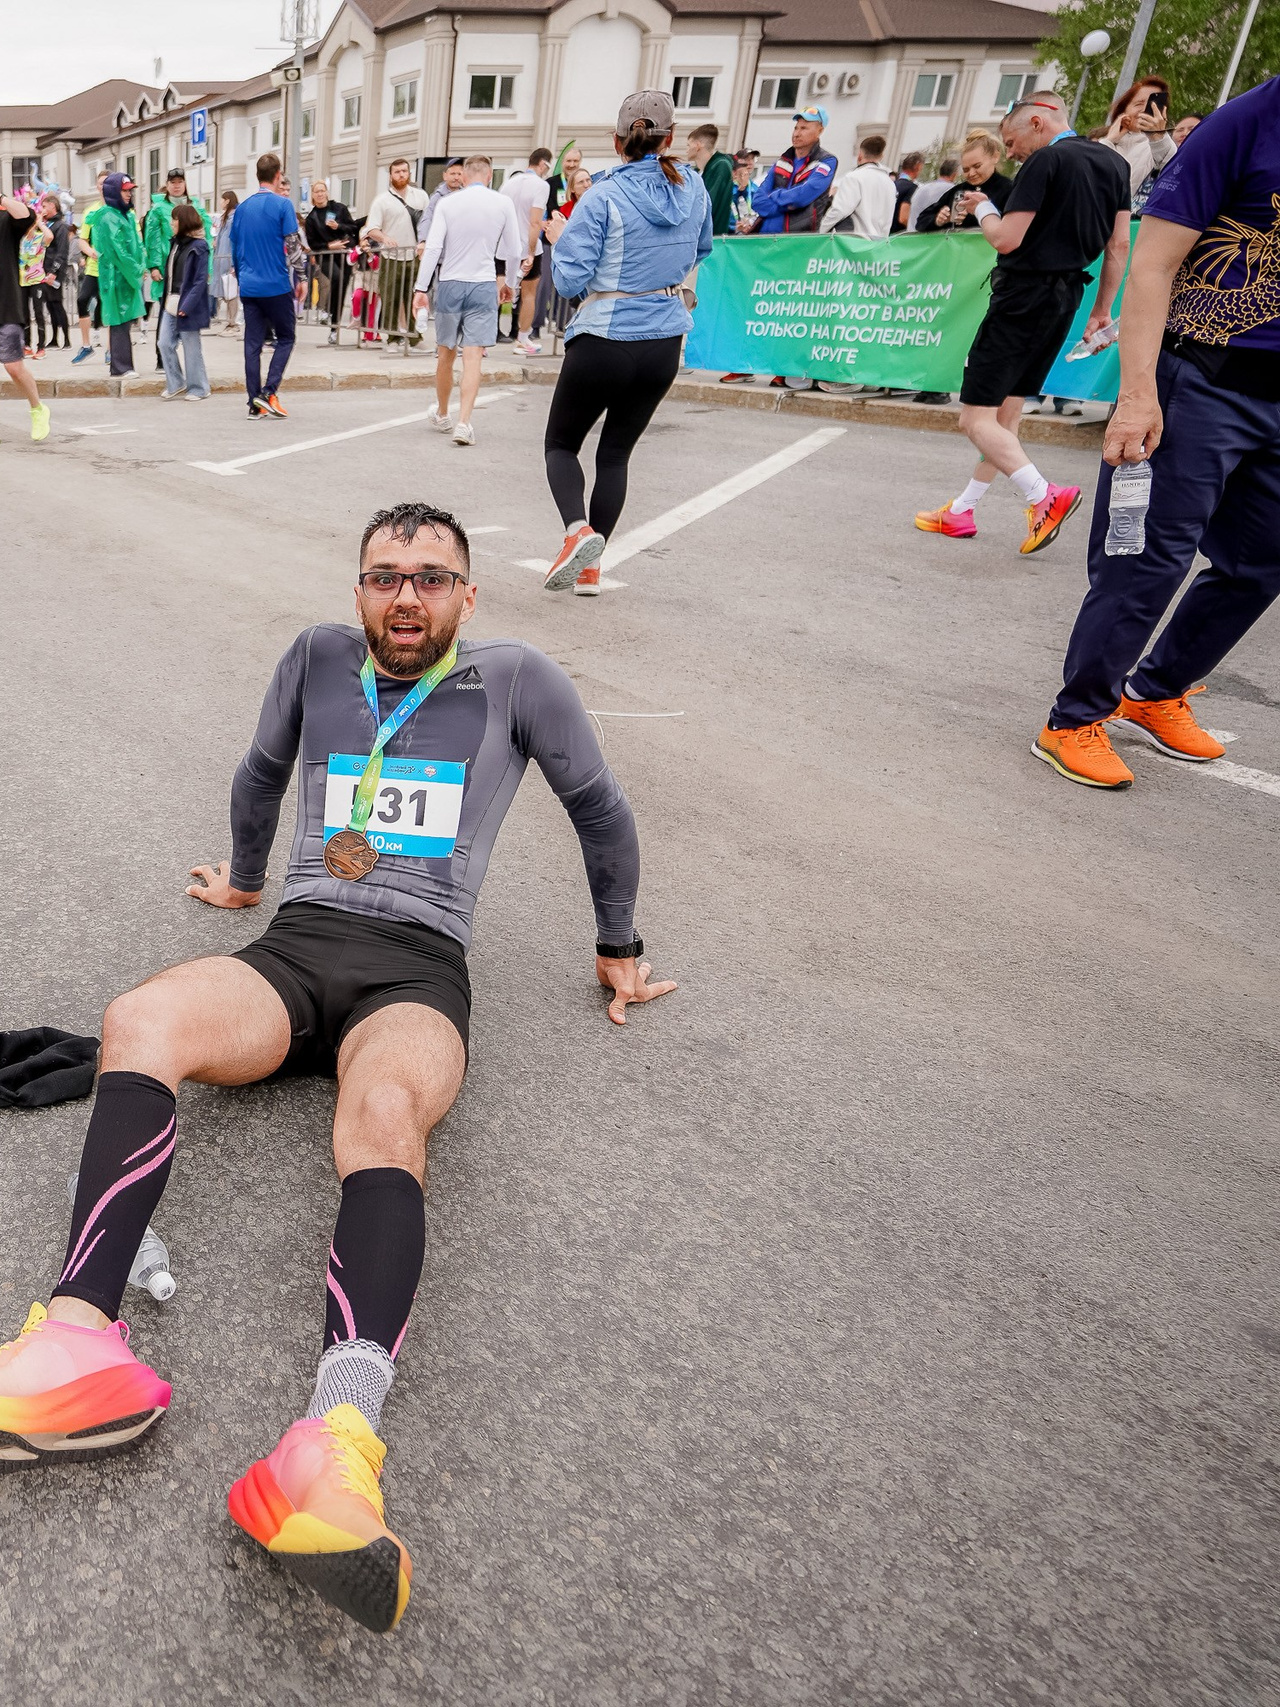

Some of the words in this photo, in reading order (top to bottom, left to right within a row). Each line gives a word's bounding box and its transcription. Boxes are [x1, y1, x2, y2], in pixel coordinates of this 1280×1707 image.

[194, 113, 205, 143] P
[806, 258, 902, 277] ВНИМАНИЕ
[750, 280, 854, 298] ДИСТАНЦИИ
[754, 301, 881, 321] ФИНИШИРУЮТ
[881, 306, 893, 322] В
[894, 306, 941, 323] АРКУ
[745, 321, 808, 339] ТОЛЬКО
[810, 324, 830, 340] НА
[831, 325, 943, 347] ПОСЛЕДНЕМ
[811, 346, 859, 365] КРУГЕ
